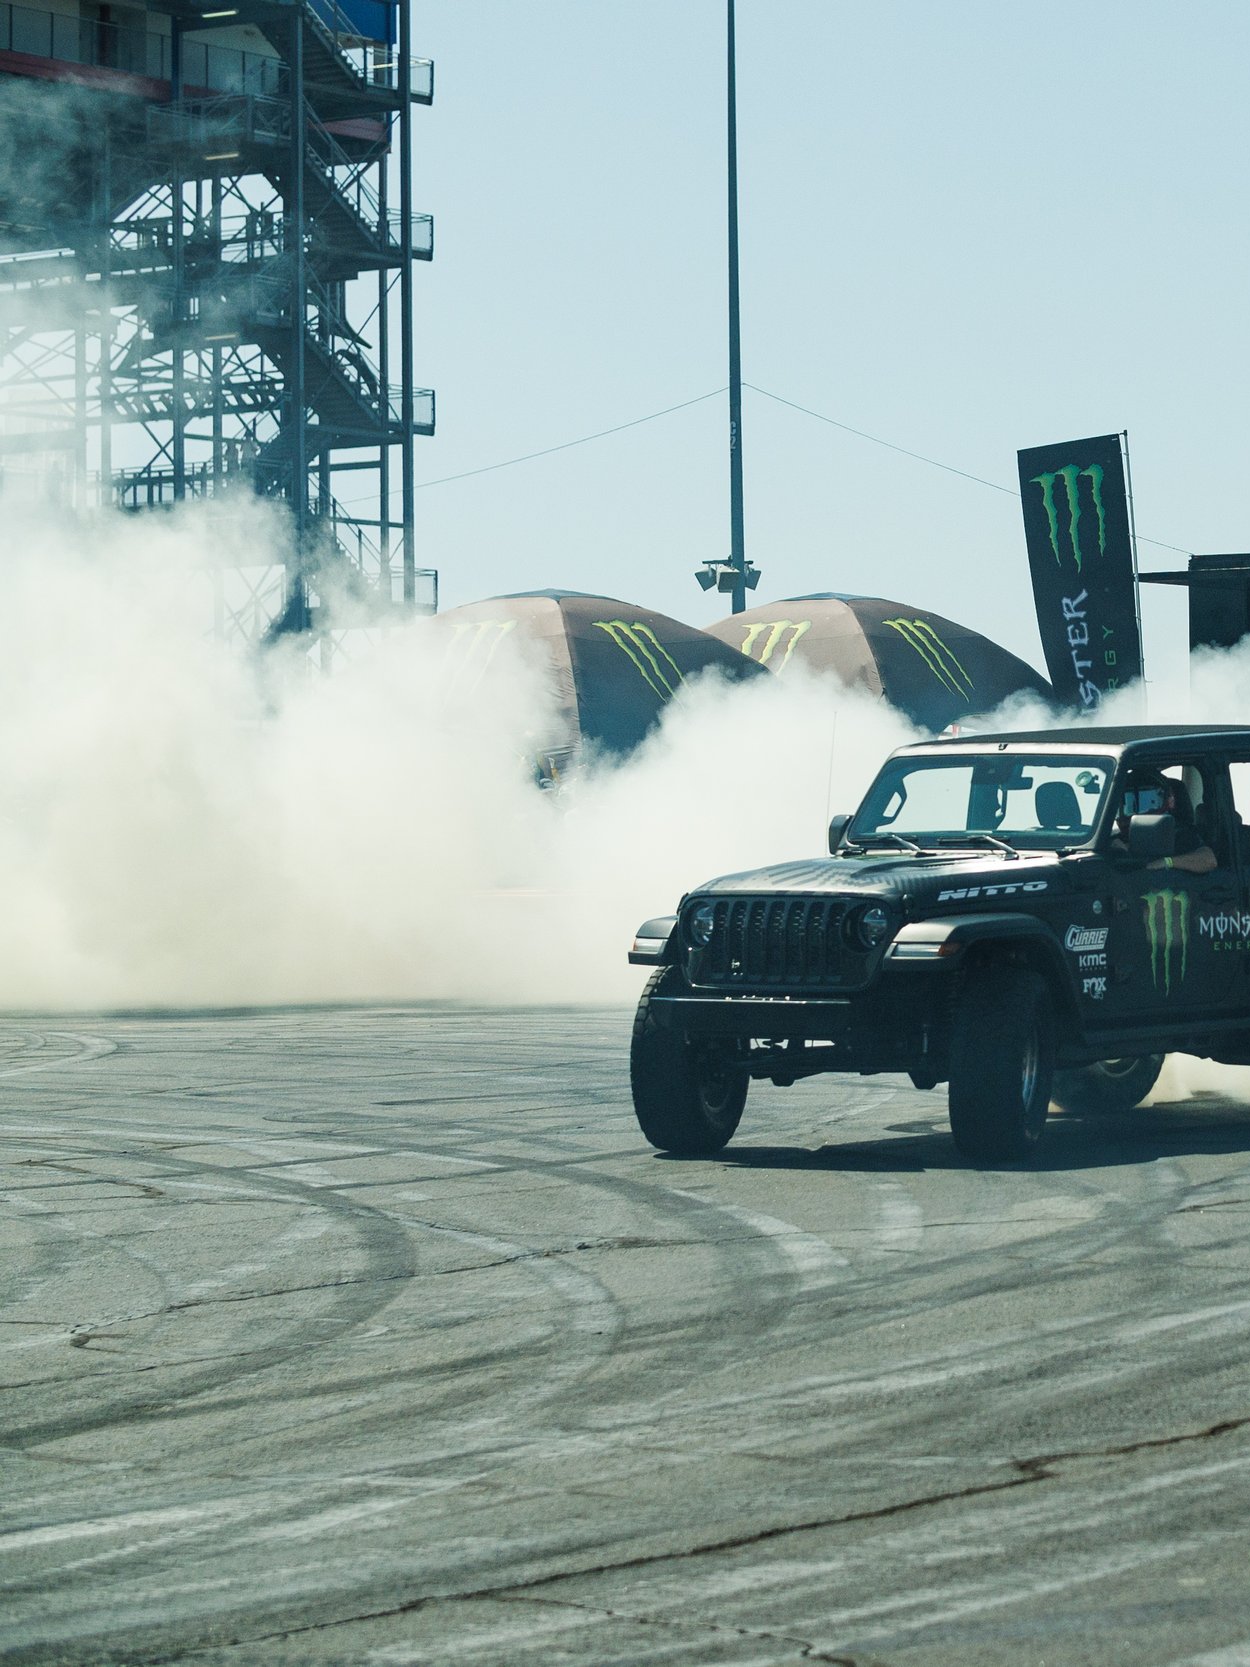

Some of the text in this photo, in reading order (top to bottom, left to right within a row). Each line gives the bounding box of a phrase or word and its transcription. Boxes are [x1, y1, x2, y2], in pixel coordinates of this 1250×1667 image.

[937, 881, 1048, 901] NITTO
[1067, 927, 1106, 949] CURRIE
[1079, 953, 1107, 968] KMC
[1083, 977, 1107, 997] FOX
